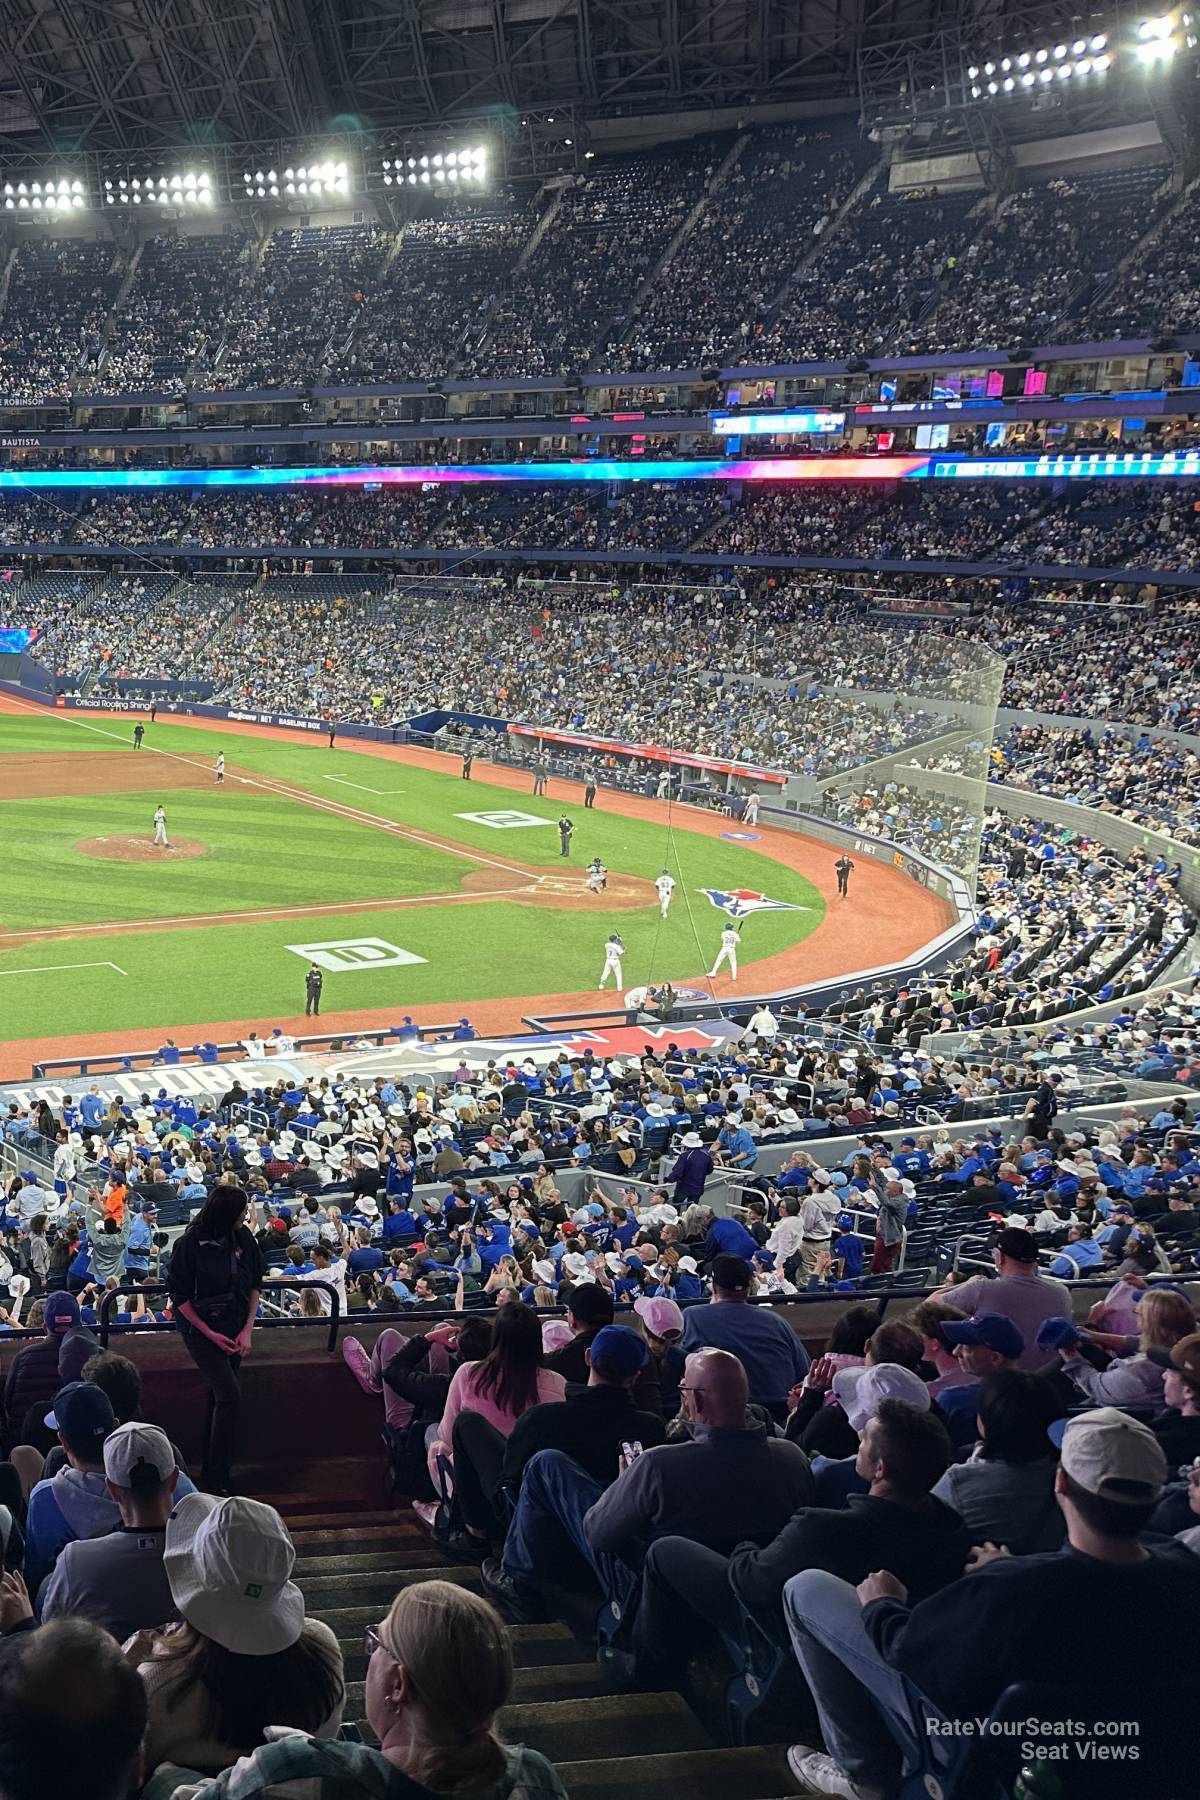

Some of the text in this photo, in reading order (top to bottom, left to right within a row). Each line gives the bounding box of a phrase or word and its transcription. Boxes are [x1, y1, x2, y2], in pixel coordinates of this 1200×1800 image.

[1, 438, 41, 446] BAUTISTA
[75, 699, 101, 708] Official
[101, 699, 129, 710] Roofing
[129, 701, 152, 711] Shingl
[228, 711, 272, 724] theScore BET
[279, 718, 321, 730] BASELINE BOX
[863, 843, 877, 855] BET
[303, 944, 400, 963] TD
[3, 1086, 70, 1110] TO
[114, 1062, 281, 1101] CORE
